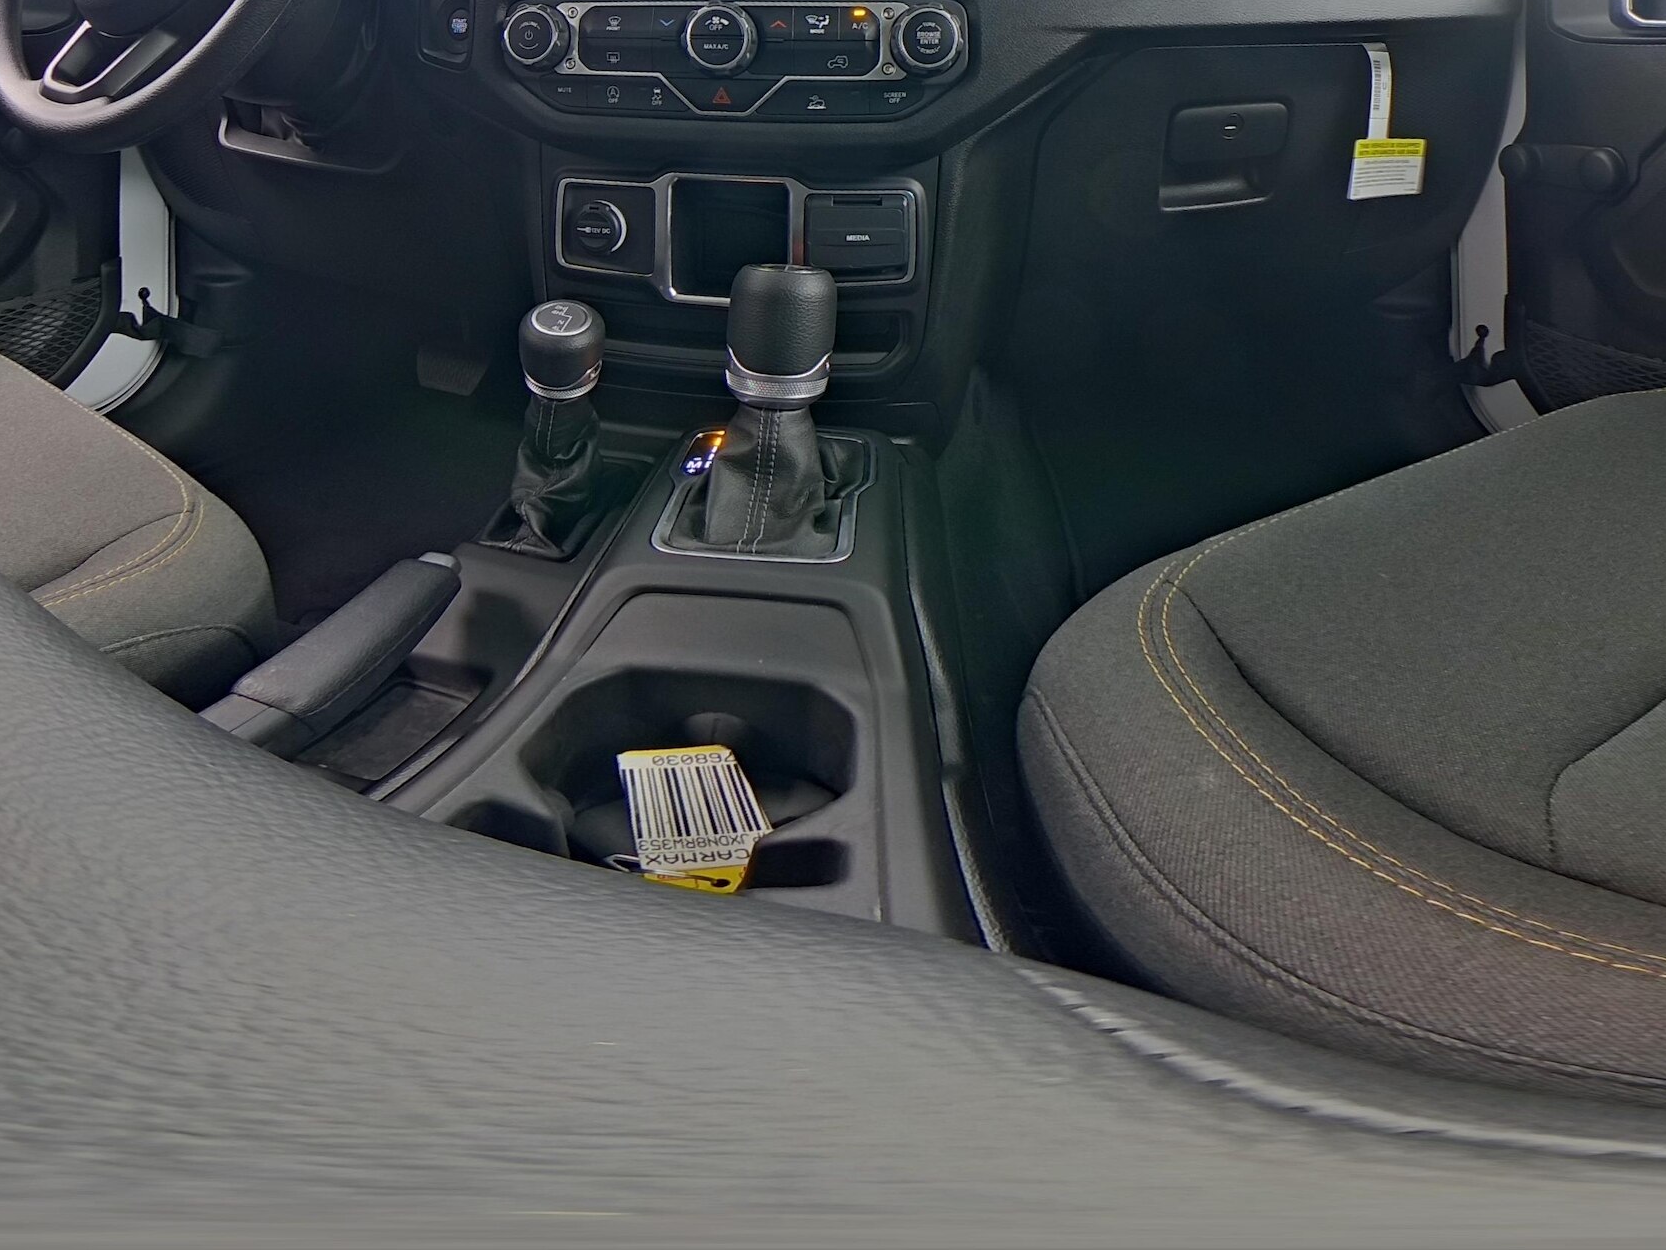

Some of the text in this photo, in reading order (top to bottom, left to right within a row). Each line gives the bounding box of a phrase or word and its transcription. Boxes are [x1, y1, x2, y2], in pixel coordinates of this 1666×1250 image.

[916, 31, 942, 39] BROWSE
[686, 460, 703, 468] M
[646, 848, 751, 866] CARMAX
